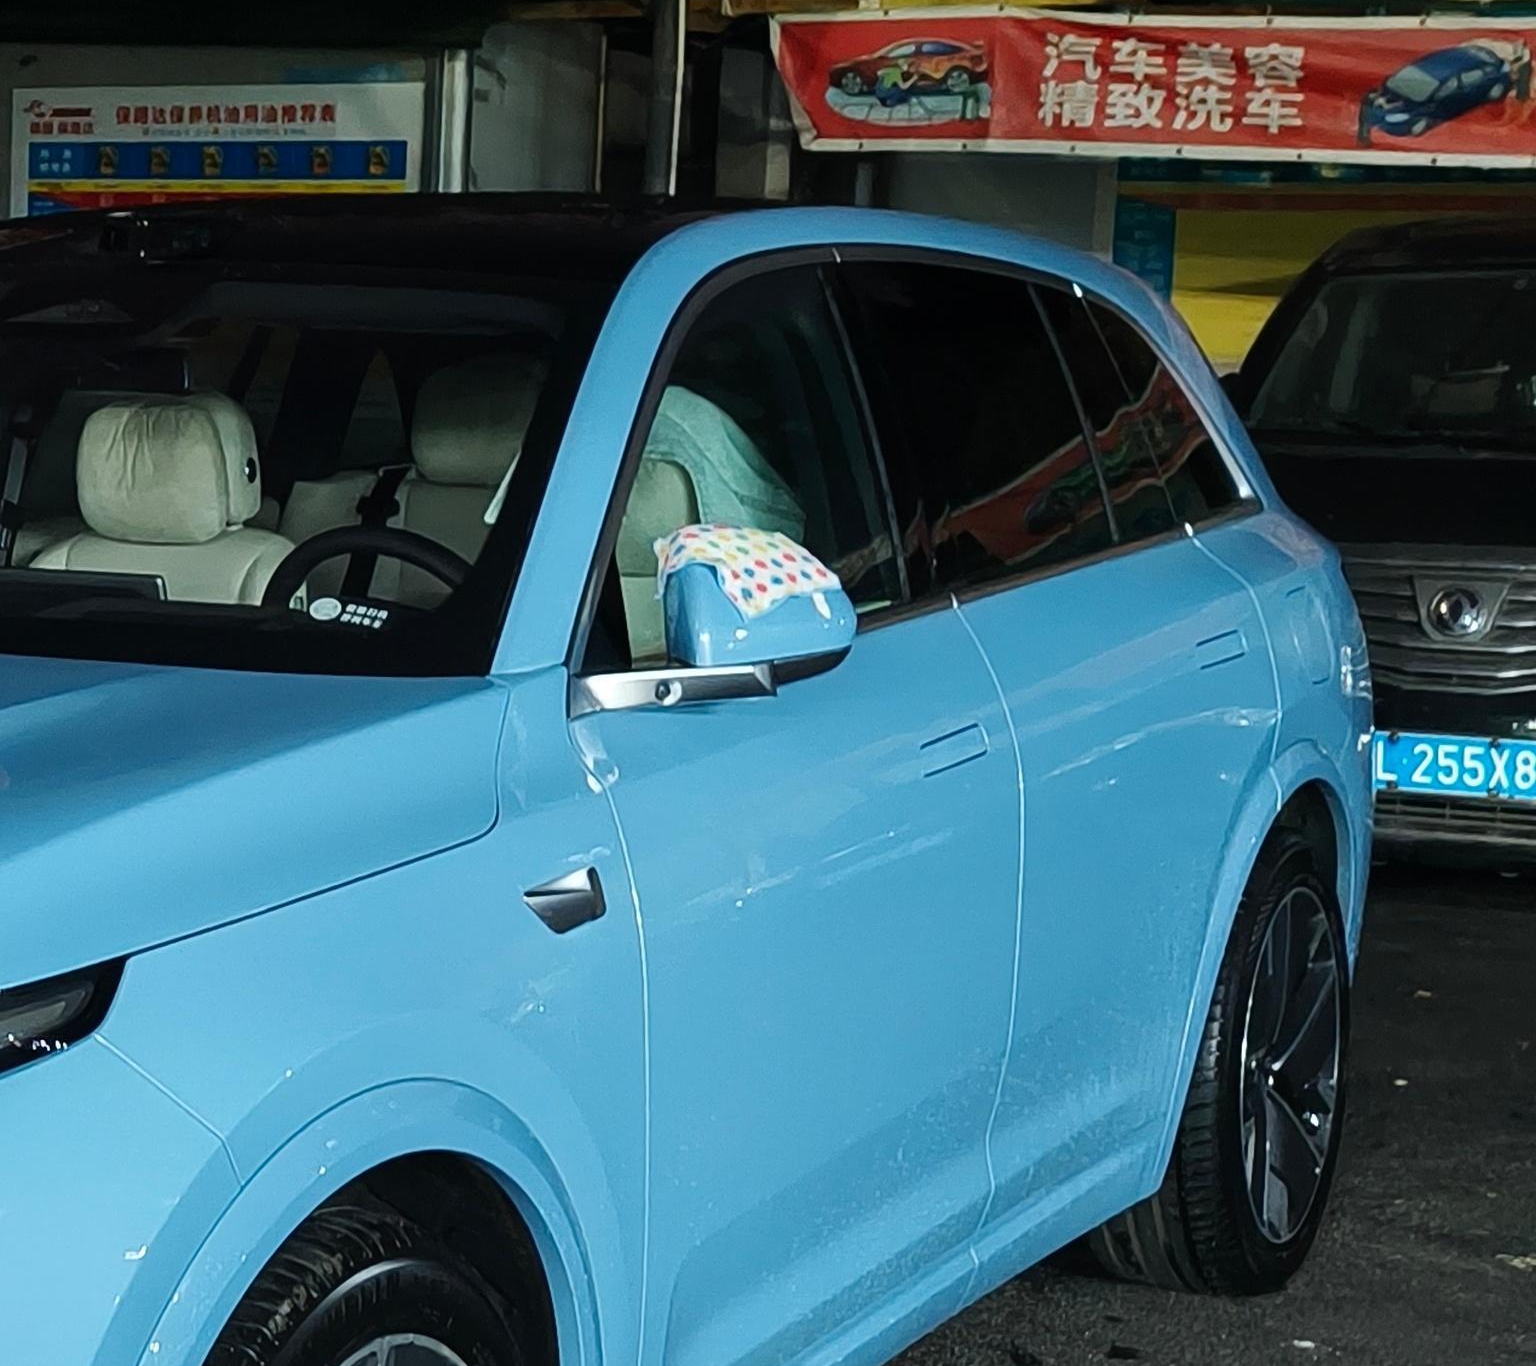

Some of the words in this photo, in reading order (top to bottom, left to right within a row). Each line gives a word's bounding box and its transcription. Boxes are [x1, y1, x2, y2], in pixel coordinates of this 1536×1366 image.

[1042, 32, 1305, 88] 汽车美容
[1037, 79, 1305, 134] 精致洗车
